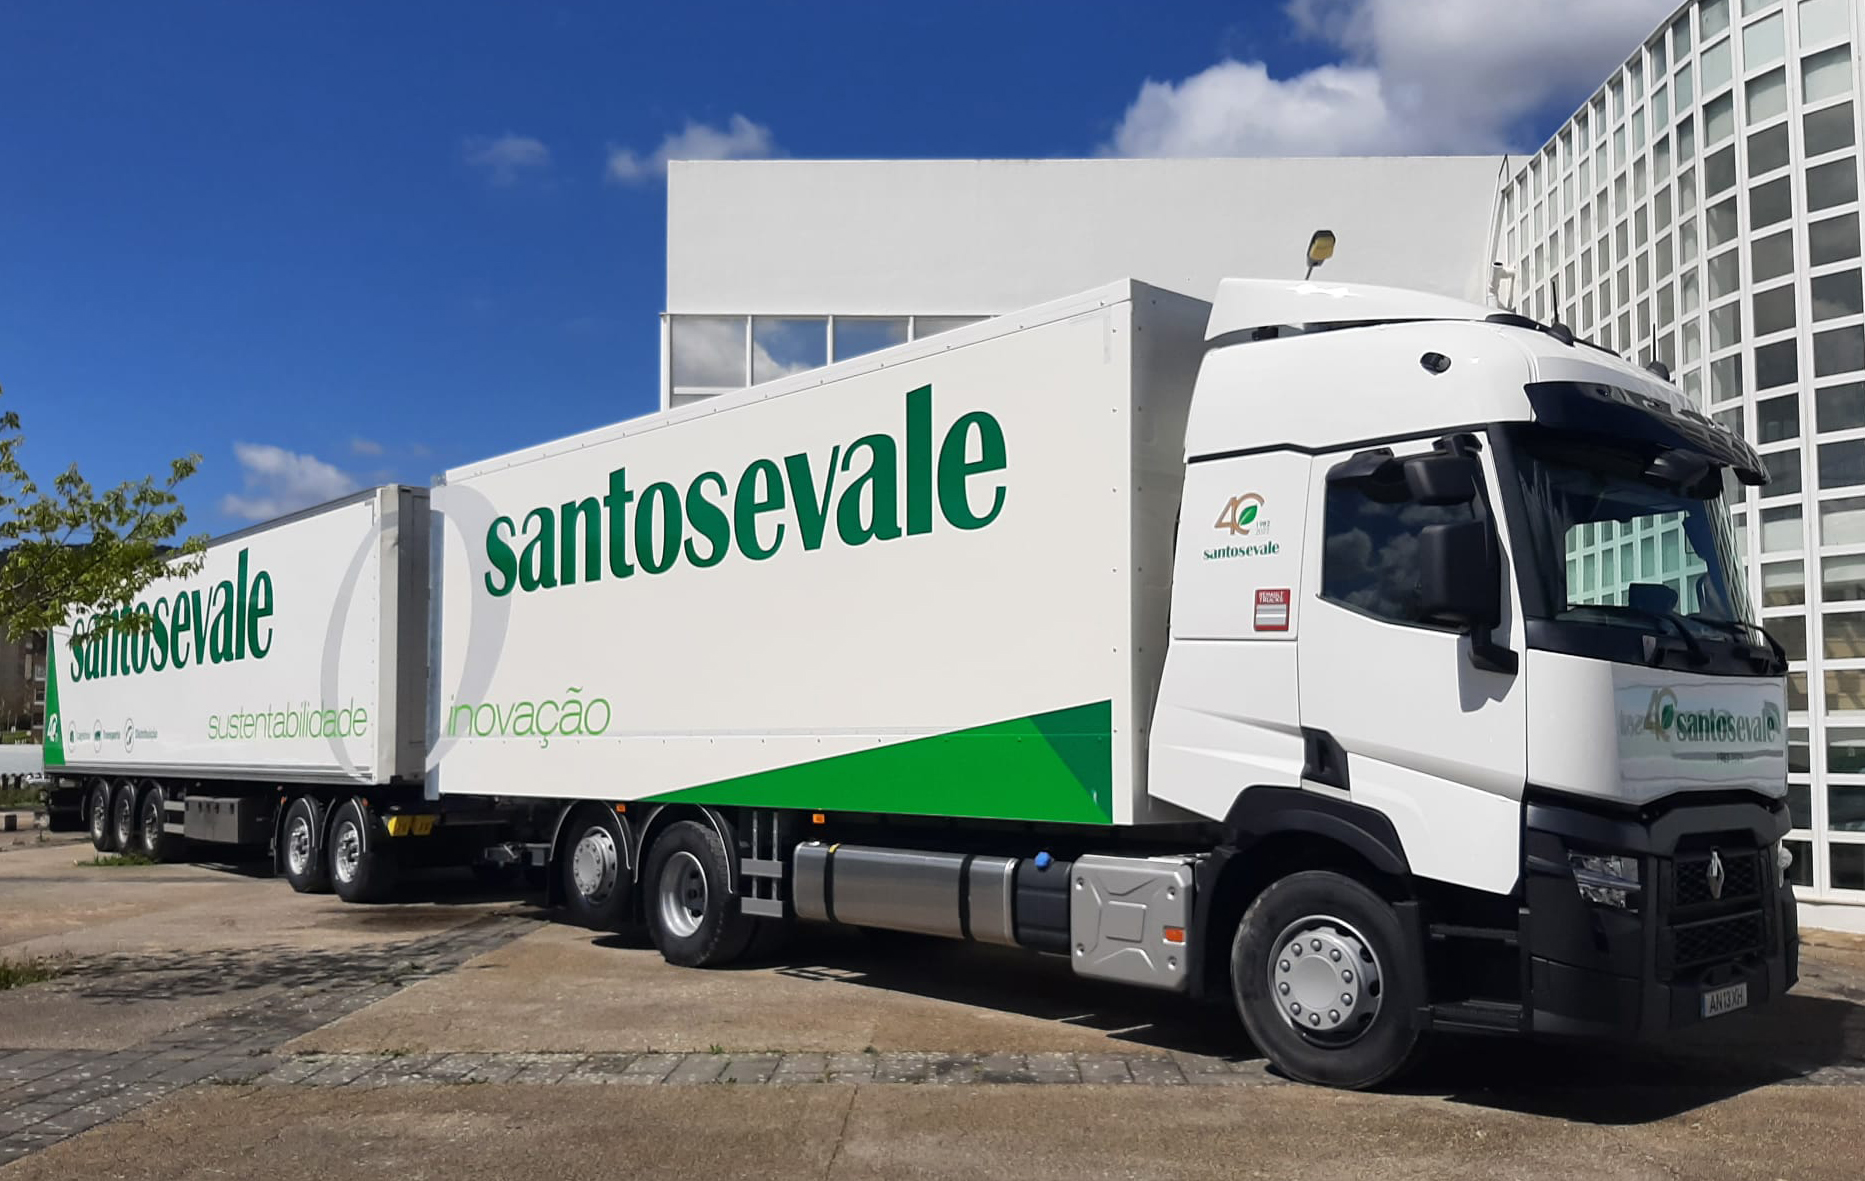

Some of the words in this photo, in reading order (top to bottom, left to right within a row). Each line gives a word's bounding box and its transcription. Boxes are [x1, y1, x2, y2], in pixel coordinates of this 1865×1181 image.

[484, 383, 1007, 598] santosevale
[1203, 540, 1279, 560] santosevale
[70, 547, 274, 683] santosevale
[208, 697, 368, 739] sustentabilidade
[448, 686, 611, 749] inovação
[1676, 707, 1775, 742] santosevale
